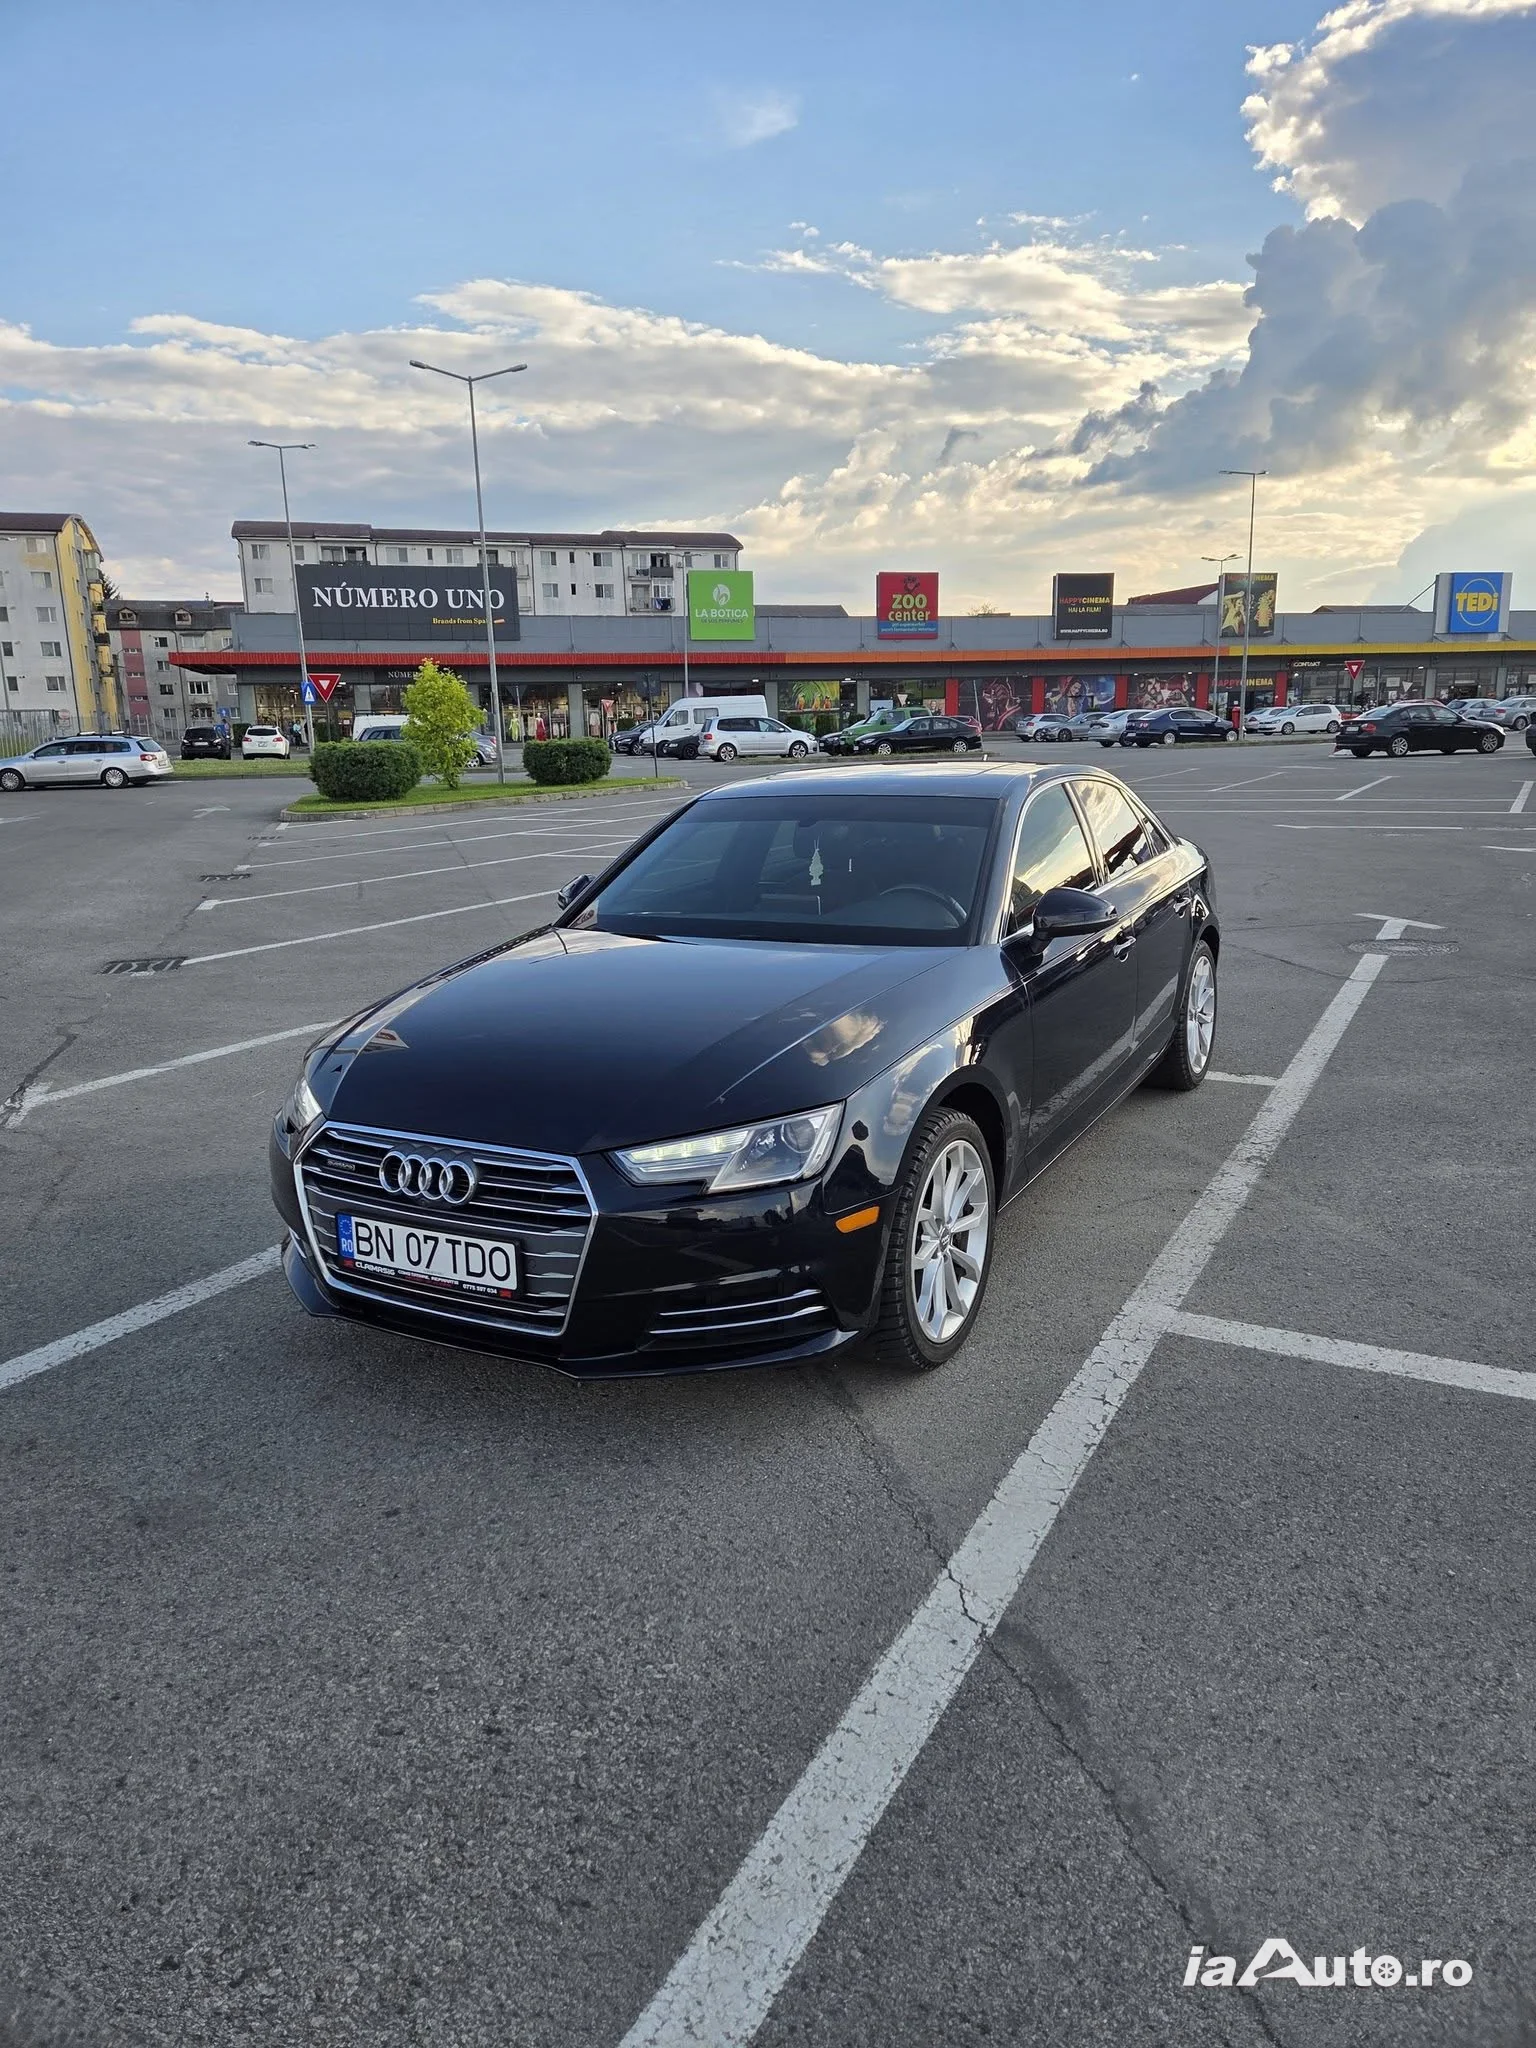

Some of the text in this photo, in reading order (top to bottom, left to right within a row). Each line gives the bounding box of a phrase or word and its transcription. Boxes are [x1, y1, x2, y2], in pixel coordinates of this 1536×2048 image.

[312, 581, 505, 609] NÚMERO UNO
[892, 594, 927, 609] ZOO
[1456, 592, 1499, 612] TEDi
[695, 608, 749, 618] LA BOTICA
[888, 609, 931, 622] center
[341, 1238, 354, 1253] RO
[355, 1222, 511, 1281] BN 07 TDO
